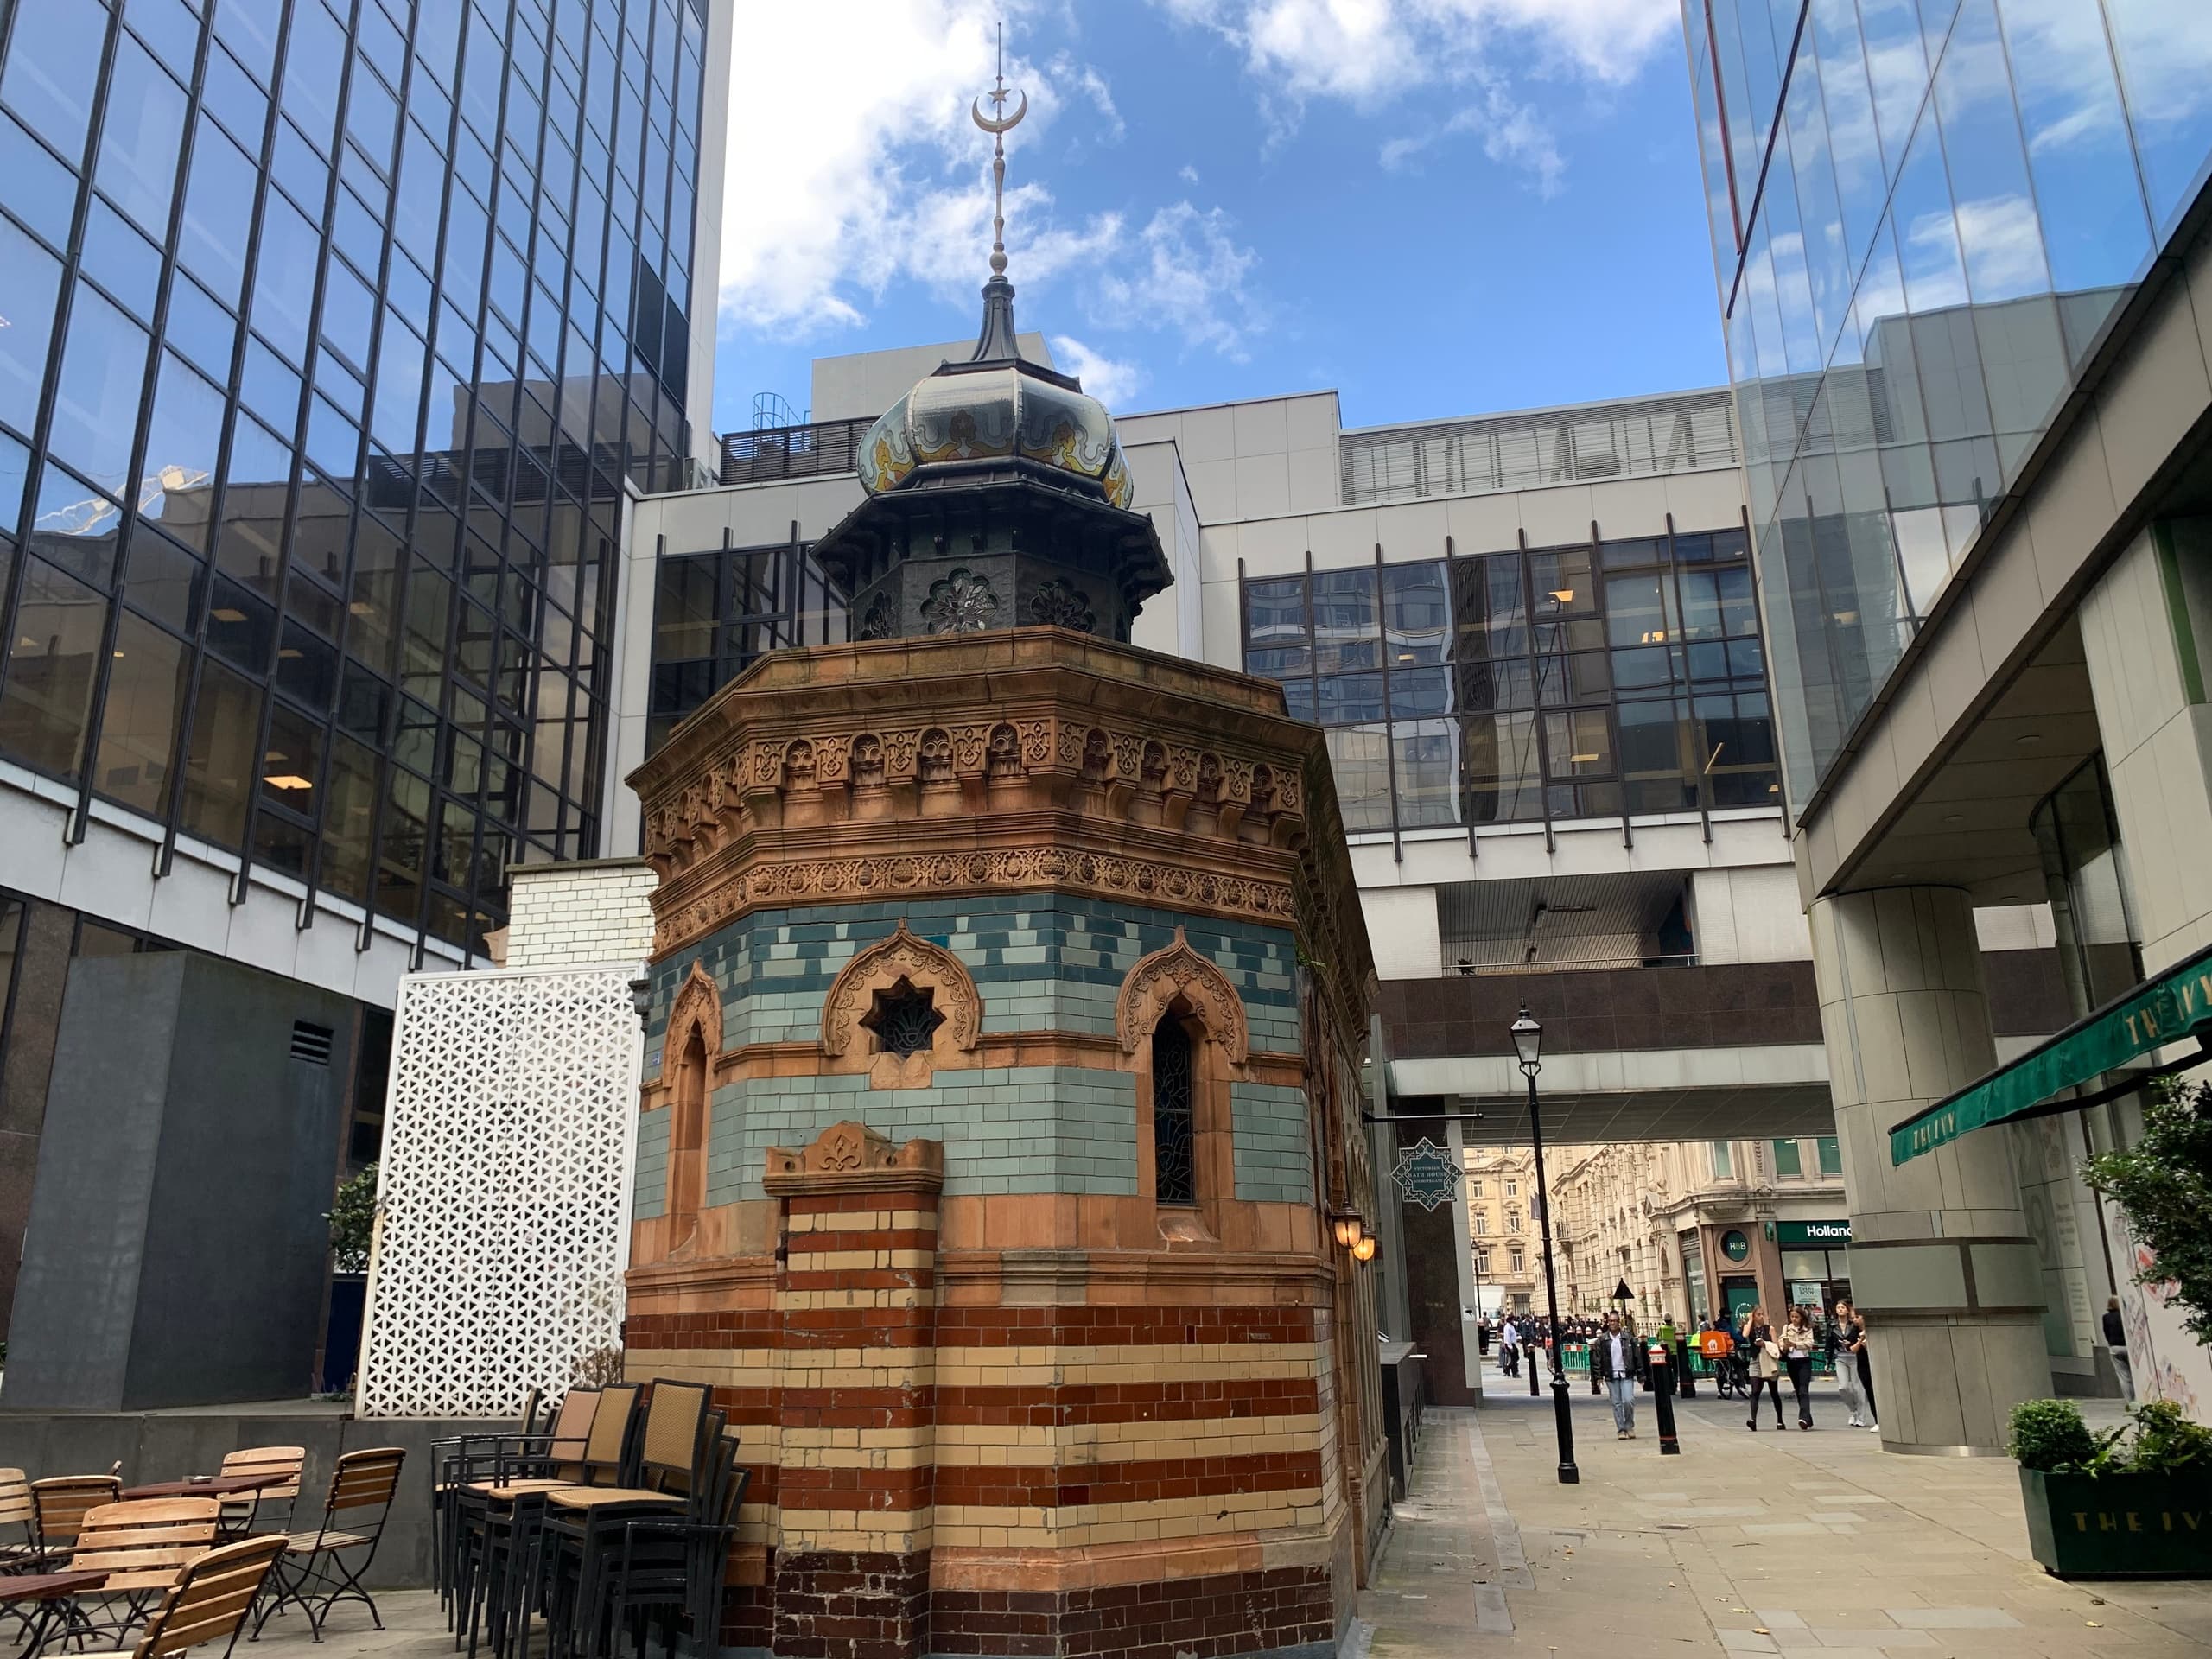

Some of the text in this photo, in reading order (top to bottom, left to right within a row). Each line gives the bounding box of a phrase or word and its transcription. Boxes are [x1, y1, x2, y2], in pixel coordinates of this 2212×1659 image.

[1913, 1110, 1955, 1150] THE IVY
[2071, 1511, 2212, 1532] THE IV
